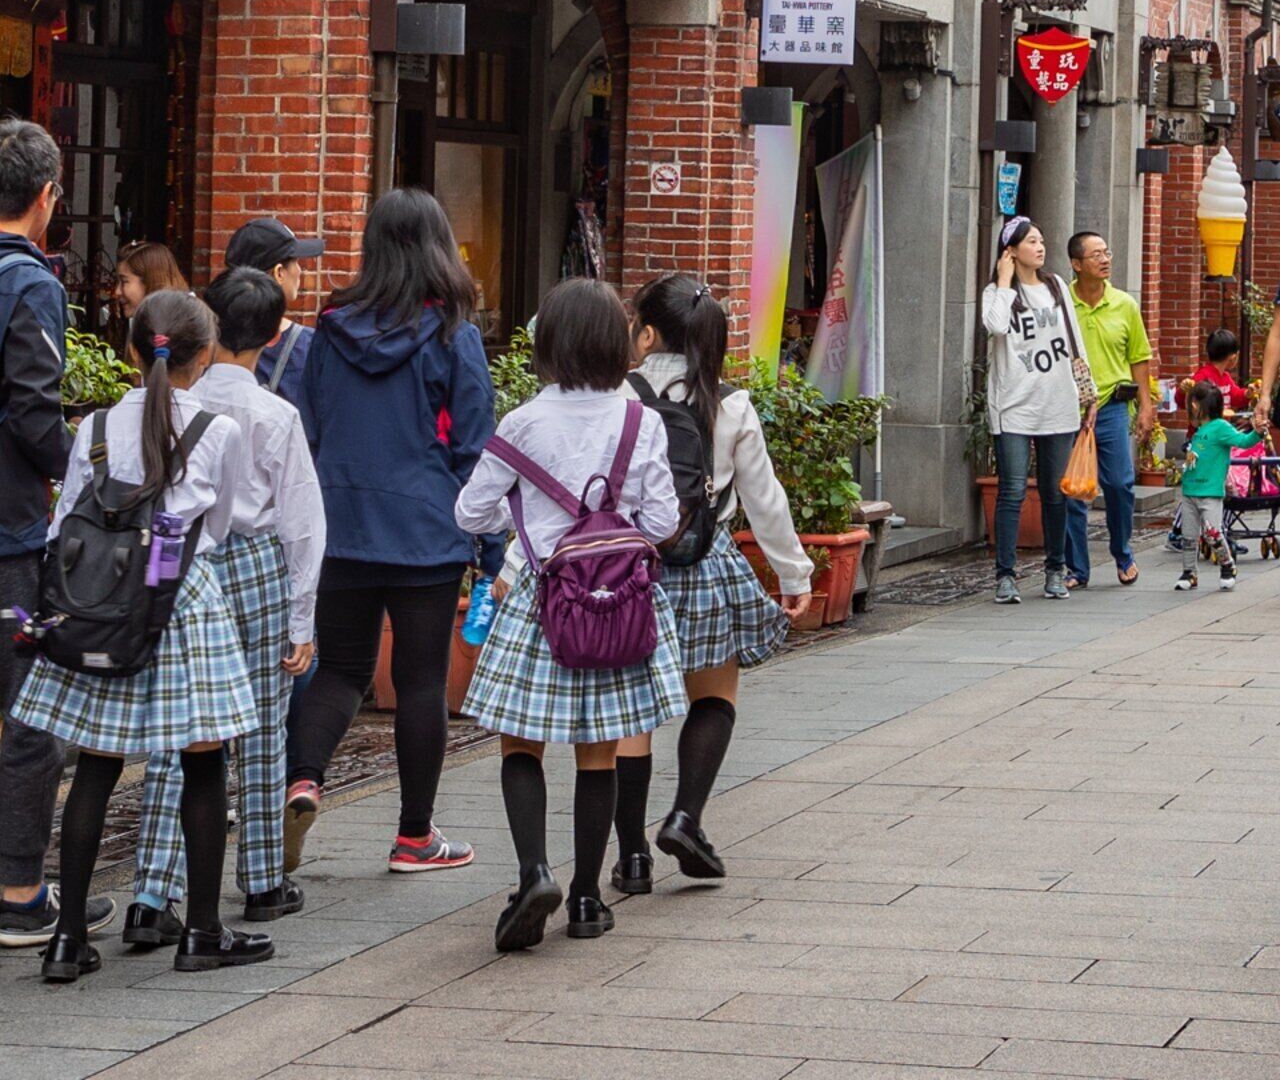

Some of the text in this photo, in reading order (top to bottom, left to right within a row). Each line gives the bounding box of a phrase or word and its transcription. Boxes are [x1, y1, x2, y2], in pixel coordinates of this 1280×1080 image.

[808, 2, 834, 11] POTTERY
[769, 40, 843, 54] 大器品味館
[1026, 49, 1079, 71] 童玩
[1035, 70, 1069, 92] 藝品
[1006, 306, 1059, 341] NEW
